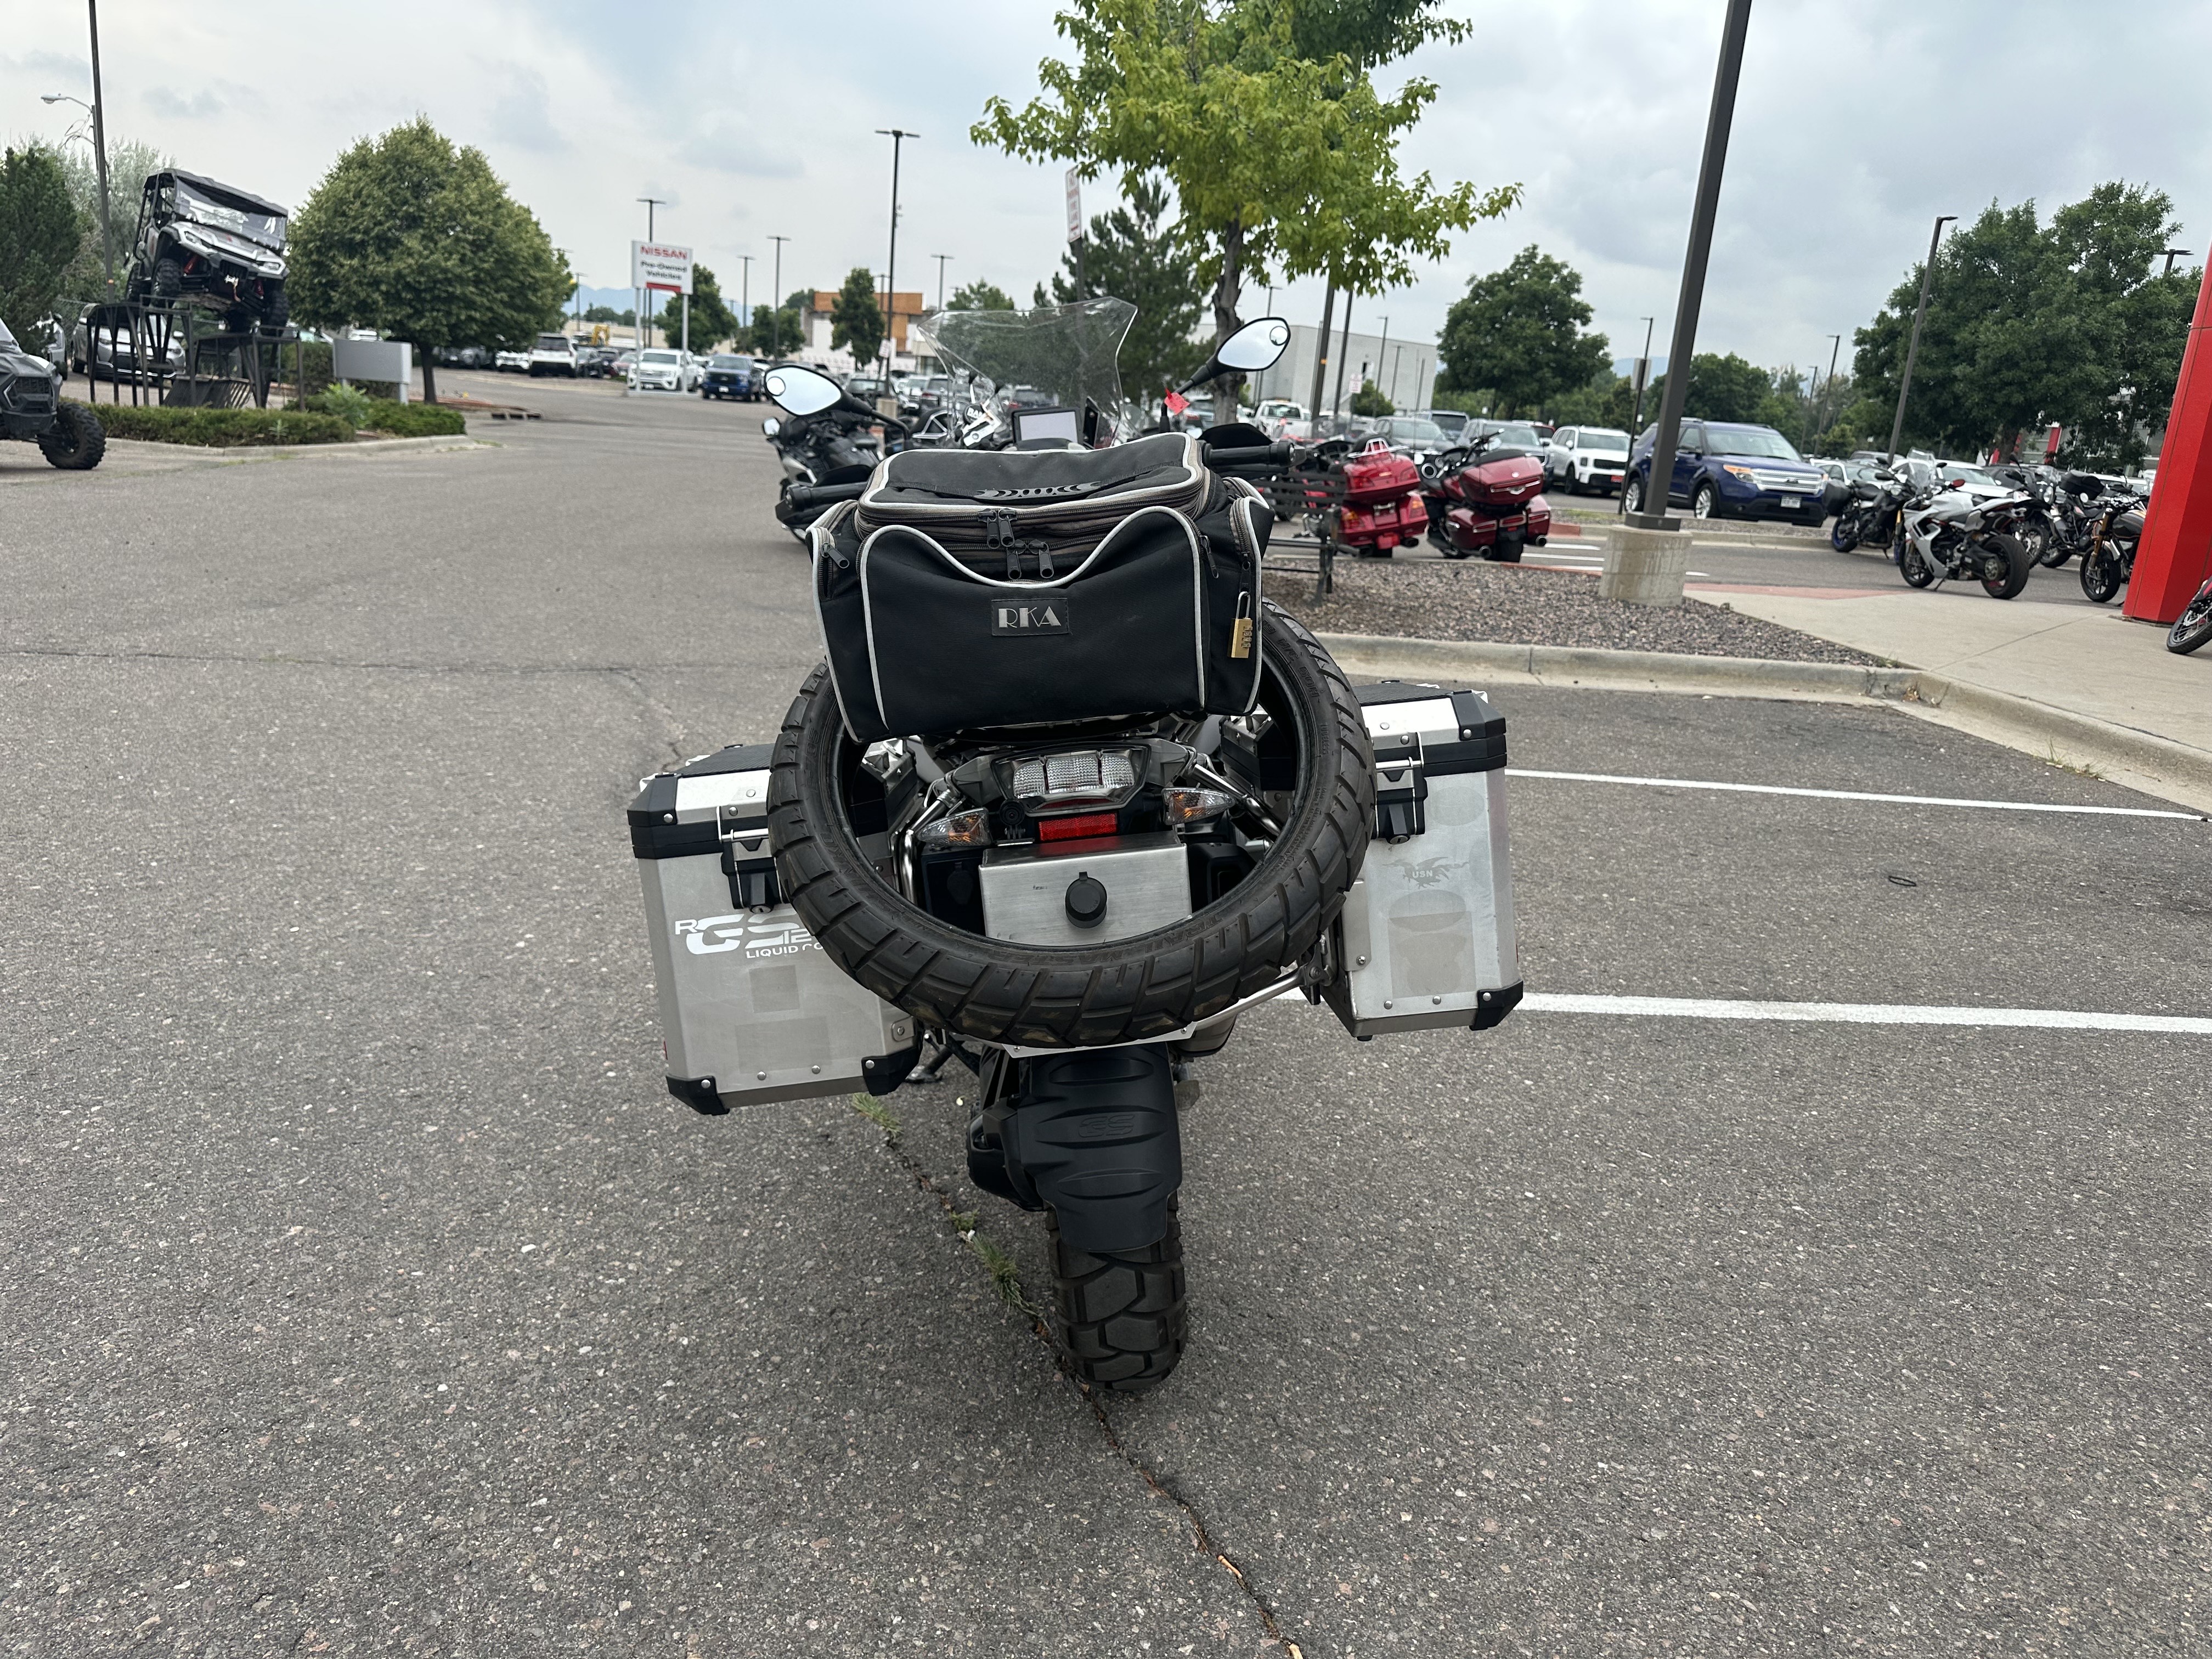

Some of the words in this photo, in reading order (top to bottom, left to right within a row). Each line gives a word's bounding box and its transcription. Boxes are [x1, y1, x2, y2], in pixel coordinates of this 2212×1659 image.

[640, 245, 687, 260] NISSAN
[641, 260, 687, 273] Pre-Owned
[646, 269, 681, 280] Vehicles
[998, 606, 1062, 628] RKA
[1299, 665, 1320, 698] 60H
[1412, 870, 1434, 878] USN
[686, 908, 800, 955] GS
[746, 944, 799, 959] LIQUID
[1078, 1114, 1135, 1138] GS
